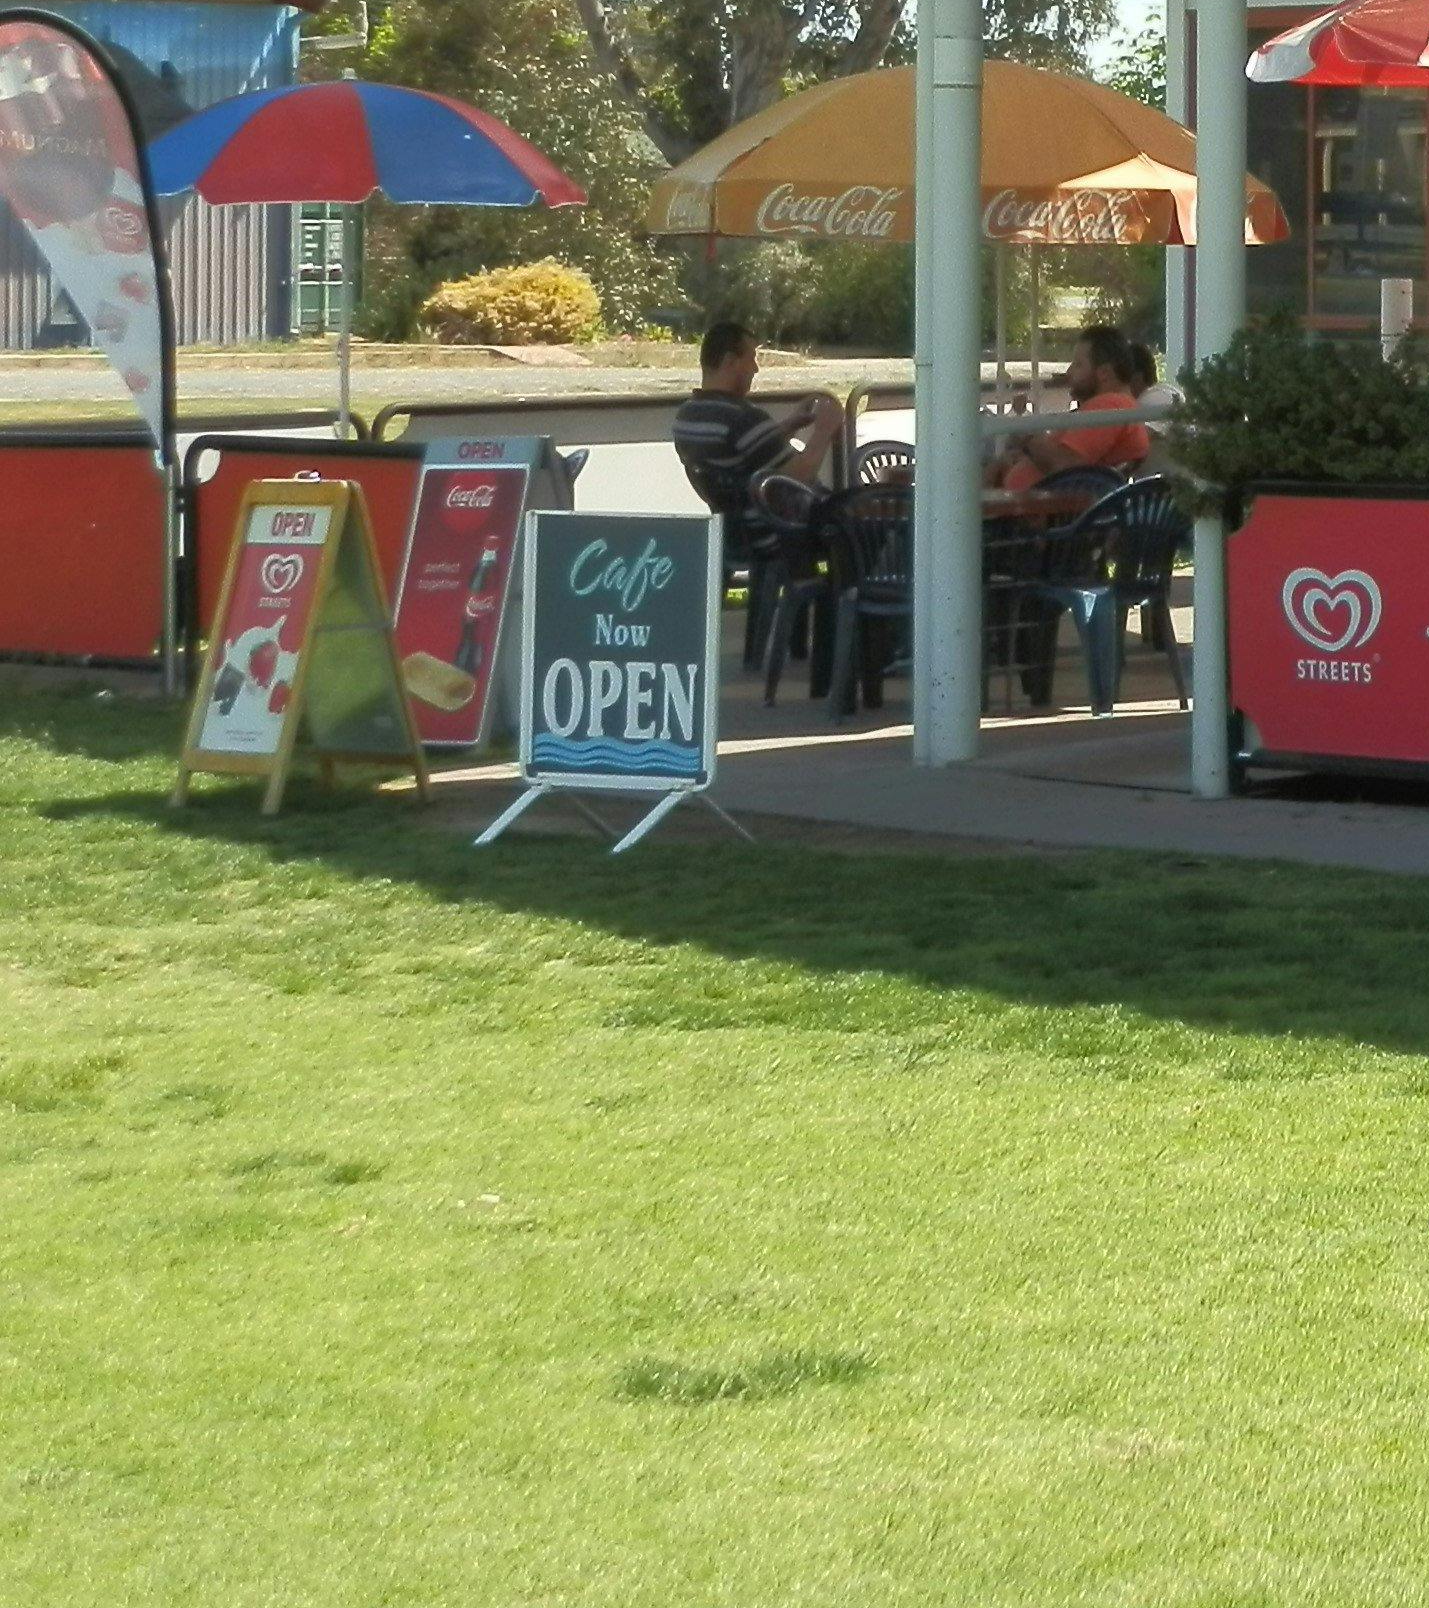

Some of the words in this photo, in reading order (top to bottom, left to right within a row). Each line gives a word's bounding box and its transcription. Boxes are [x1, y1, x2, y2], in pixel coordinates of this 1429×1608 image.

[458, 441, 505, 459] OPEN
[271, 511, 316, 537] OPEN
[594, 613, 651, 647] Now
[1297, 659, 1372, 683] STREETS
[543, 657, 698, 741] OPEN
